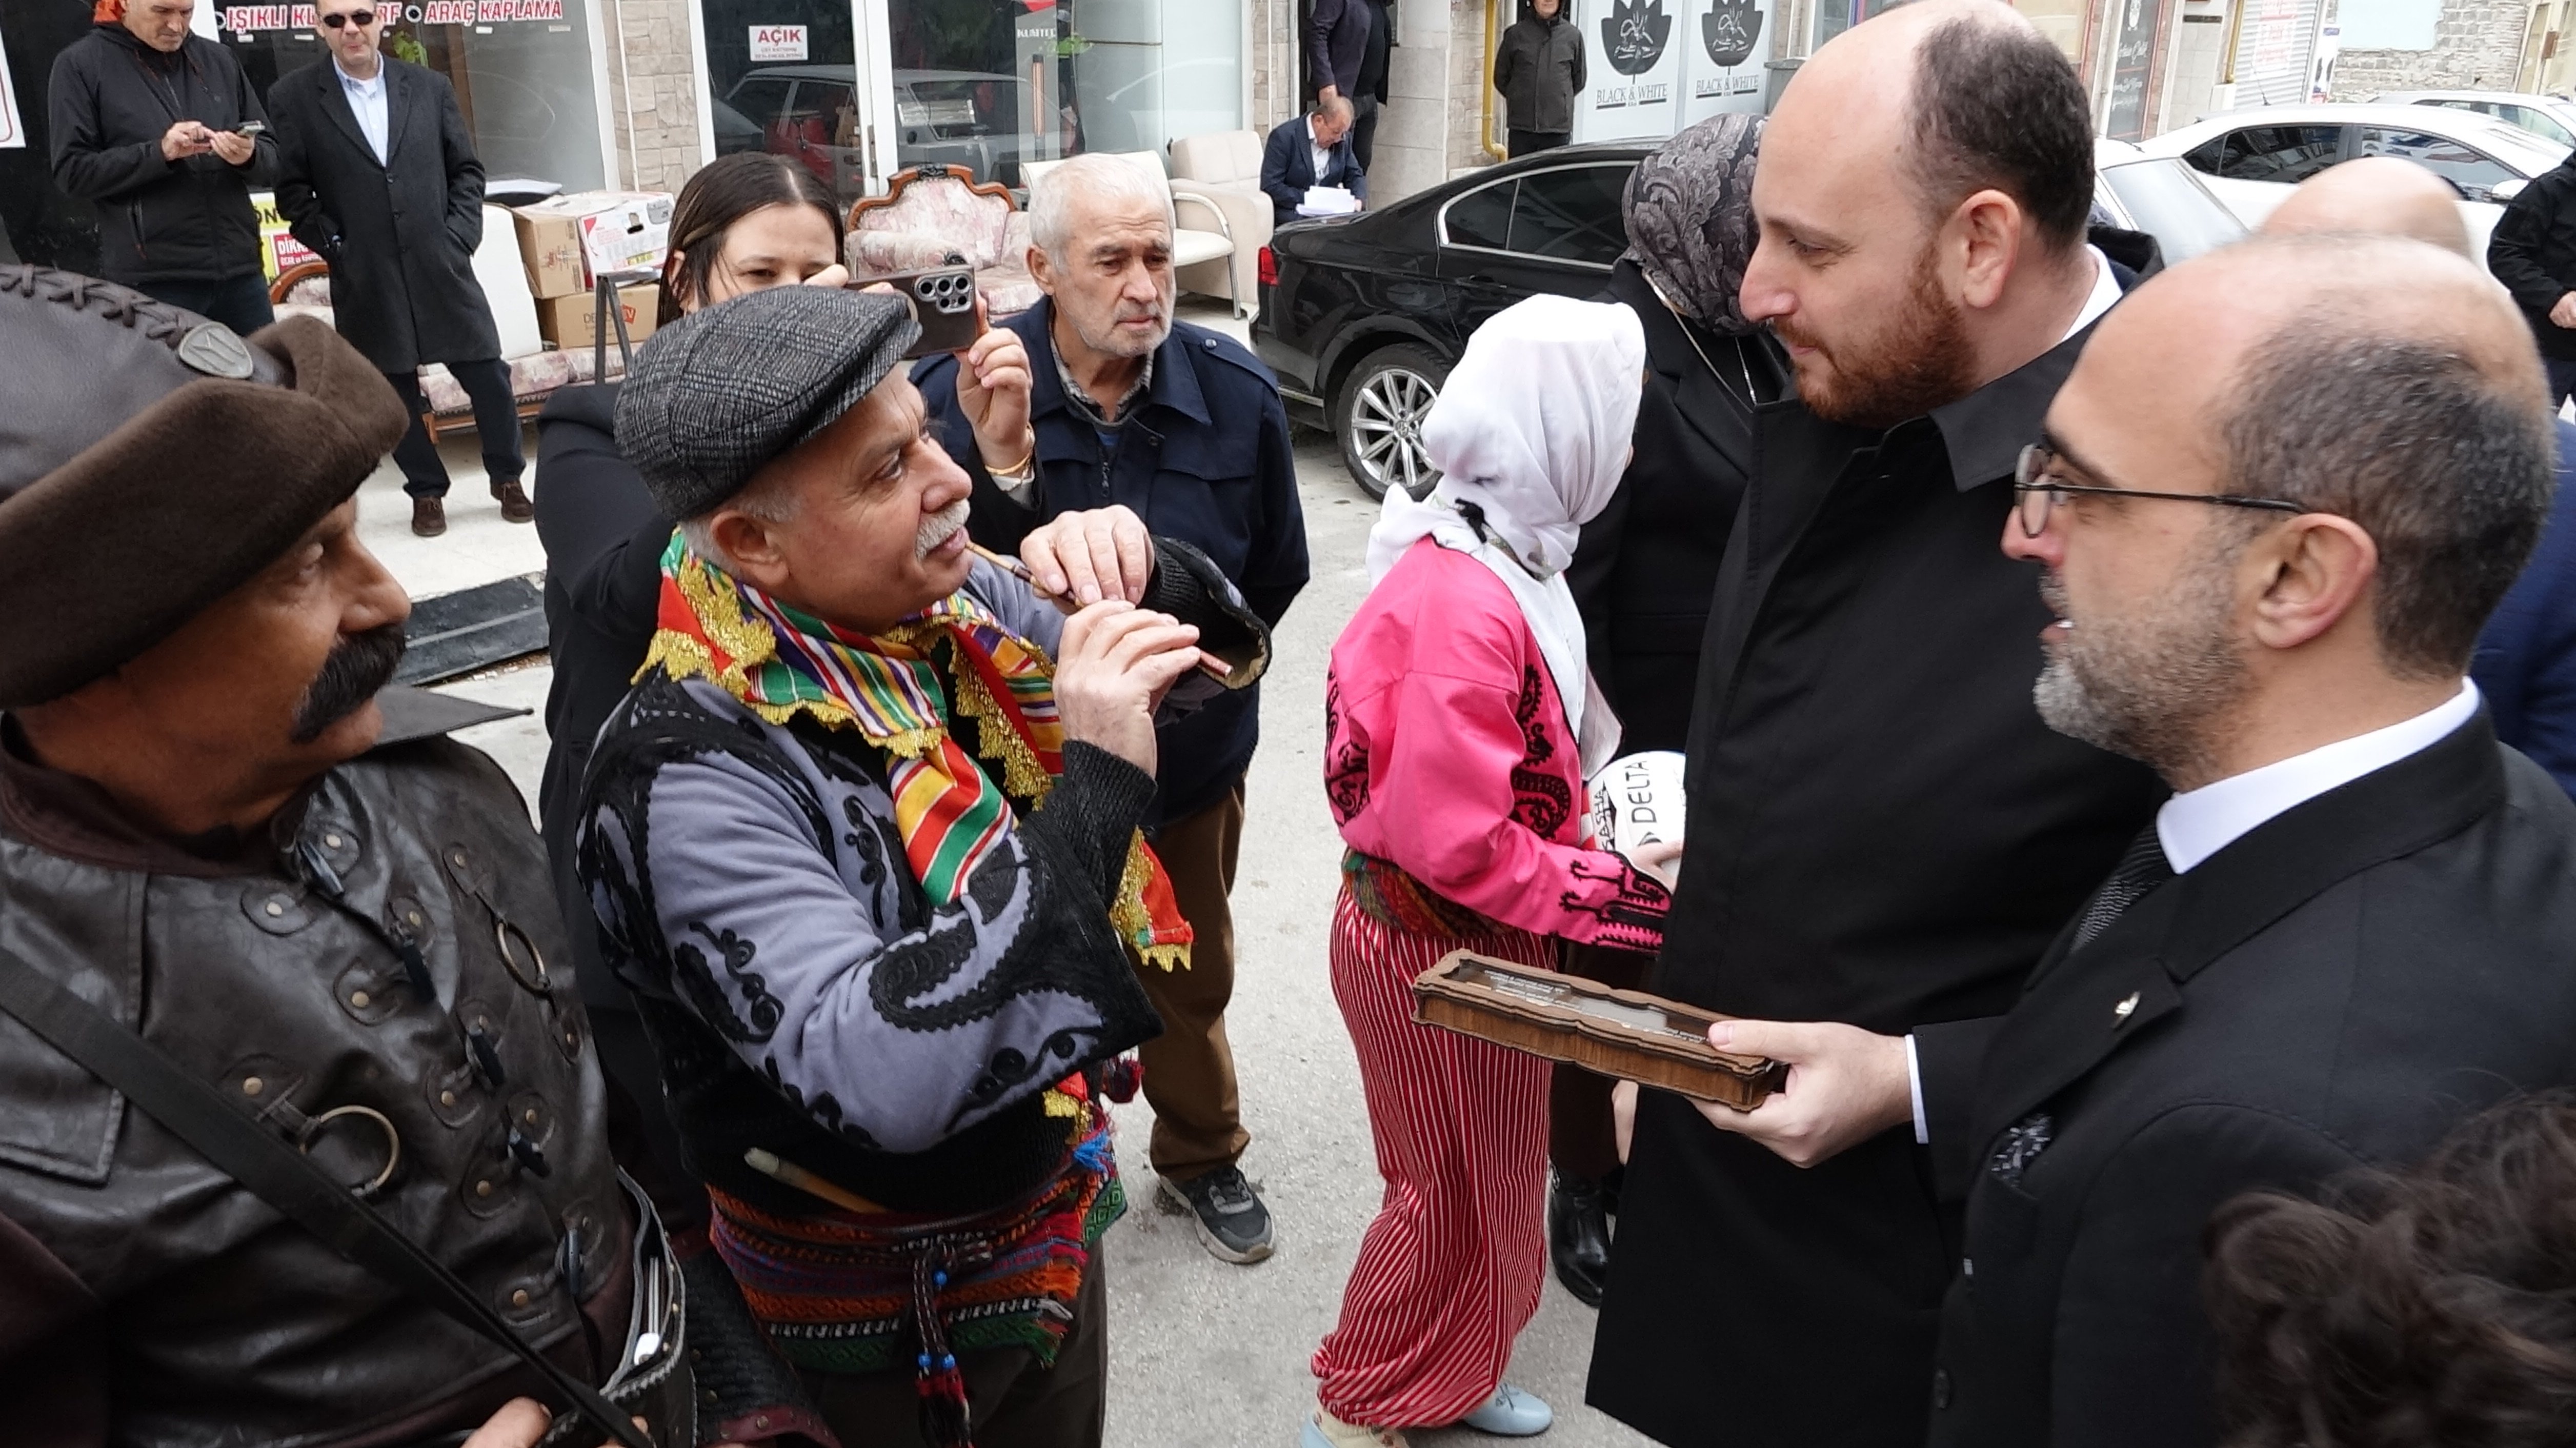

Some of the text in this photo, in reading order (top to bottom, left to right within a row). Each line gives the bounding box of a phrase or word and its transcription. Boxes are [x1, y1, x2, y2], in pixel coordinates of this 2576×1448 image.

[229, 6, 286, 33] IŞIKLI
[425, 1, 475, 26] ARAÇ
[479, 0, 562, 21] KAPLAMA
[758, 29, 801, 46] AÇIK
[1596, 83, 1667, 104] BLACK & WHITE
[1696, 74, 1759, 93] BLACK & WHITE
[1625, 760, 1657, 823] DELTA
